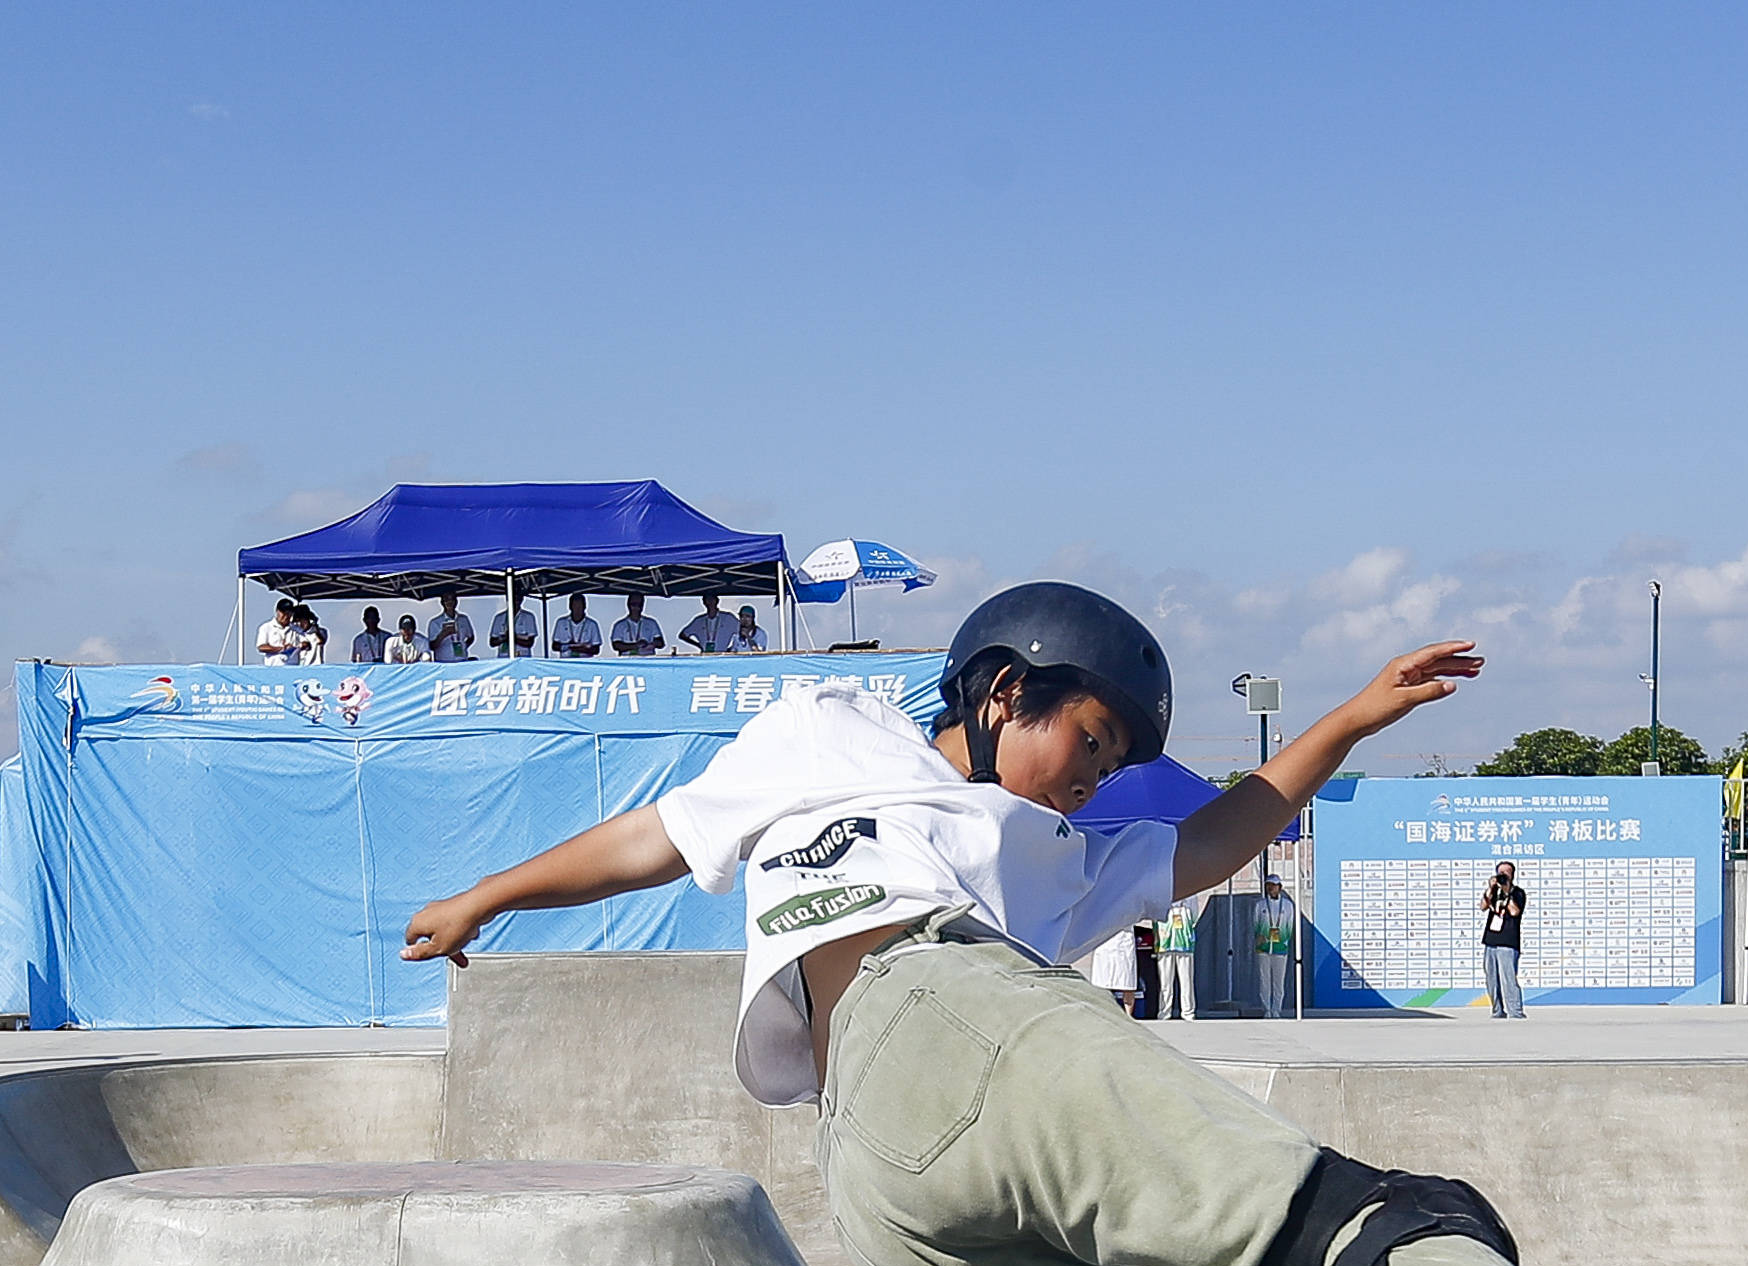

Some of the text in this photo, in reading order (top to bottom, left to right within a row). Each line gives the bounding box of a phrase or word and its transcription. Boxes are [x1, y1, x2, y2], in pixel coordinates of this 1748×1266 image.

[430, 675, 646, 716] 逐梦新时代
[780, 819, 861, 867] CHANGE
[1548, 819, 1642, 842] 滑板比赛
